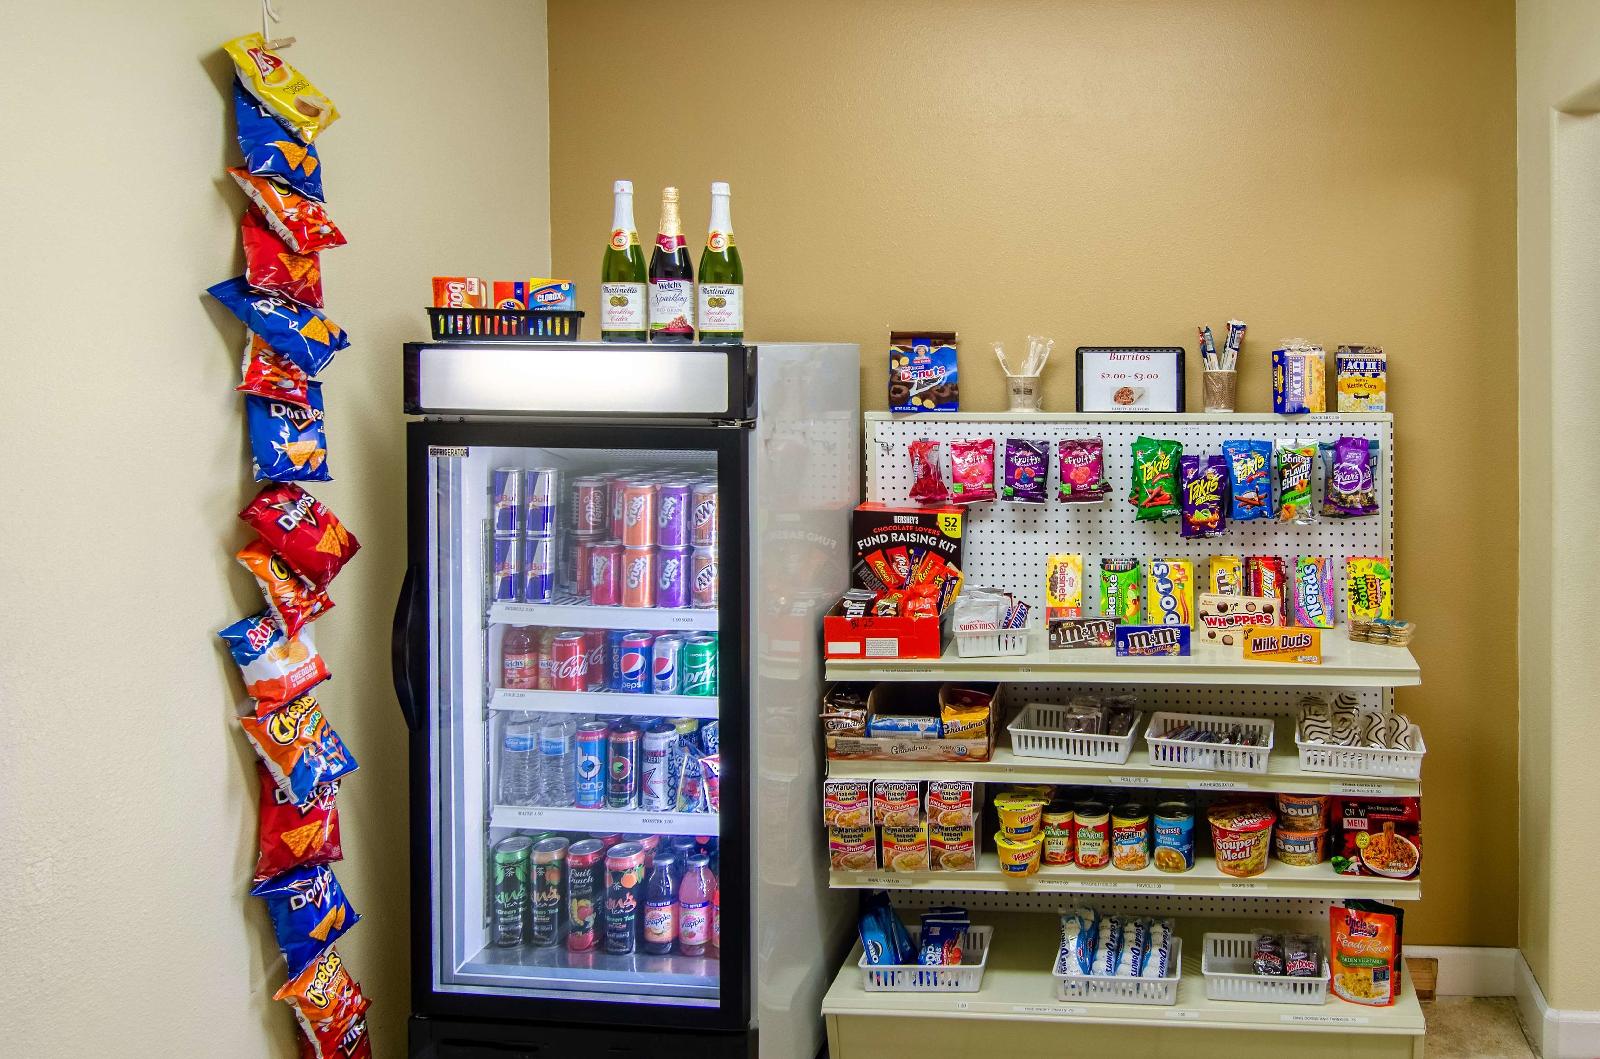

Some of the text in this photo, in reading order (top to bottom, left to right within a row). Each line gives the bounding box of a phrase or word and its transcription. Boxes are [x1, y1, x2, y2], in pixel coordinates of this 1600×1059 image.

[658, 281, 682, 289] Welch's
[536, 291, 562, 302] CLOROX
[655, 291, 688, 306] Sparkling
[1109, 353, 1151, 361] Burritos
[1346, 361, 1378, 370] ACT II
[900, 366, 946, 382] Donuts
[1134, 373, 1159, 382] $3.00
[1346, 382, 1363, 390] Kettle
[429, 447, 468, 457] REFRIGERATOR
[1013, 455, 1040, 465] Fruity
[1068, 454, 1097, 466] Fruity
[1139, 455, 1170, 483] Takis
[1233, 455, 1265, 483] Takis
[1285, 463, 1312, 478] FLAVOR
[1187, 479, 1219, 505] Takis
[276, 493, 315, 532] Doritos
[625, 494, 644, 528] Crush
[658, 495, 677, 528] Crush
[893, 515, 919, 525] HERSHEY'S
[943, 517, 958, 528] 52
[873, 526, 941, 537] CHOCOLATE LOVERS
[856, 533, 958, 554] FUND RAISING KIT
[626, 556, 648, 589] Crush
[658, 558, 680, 590] Crush
[1058, 561, 1069, 603] Raisinets
[1153, 562, 1181, 625] DOTS
[1303, 563, 1324, 618] Nerds
[1357, 575, 1368, 610] SOUR
[1367, 574, 1379, 609] PATCH
[959, 623, 997, 632] SWISS MISS
[1205, 611, 1274, 629] WHOPPERS
[1060, 620, 1115, 645] m&m's
[1128, 628, 1181, 649] m&m's
[1251, 632, 1312, 653] Milk Duds
[621, 680, 644, 690] pepsi
[268, 695, 319, 745] Cheetos
[305, 711, 323, 737] Puffs
[833, 783, 867, 792] Maruchan
[883, 783, 917, 792] Maruchan
[938, 782, 971, 791] Maruchan
[1279, 803, 1320, 818] Bowl
[838, 826, 871, 834] Maruchan
[889, 826, 924, 834] Maruchan
[1346, 819, 1366, 828] MEIN
[1215, 835, 1260, 852] Souper
[1275, 838, 1316, 854] Bowl
[1220, 848, 1253, 862] Meal
[569, 867, 592, 877] Fruit
[1105, 917, 1121, 974] SUGAR DONUTS
[1130, 920, 1144, 977] SUGAR DONUTS
[1336, 932, 1391, 954] Ready Rice
[1158, 947, 1168, 978] DONUTS
[305, 951, 342, 1009] Cheetos
